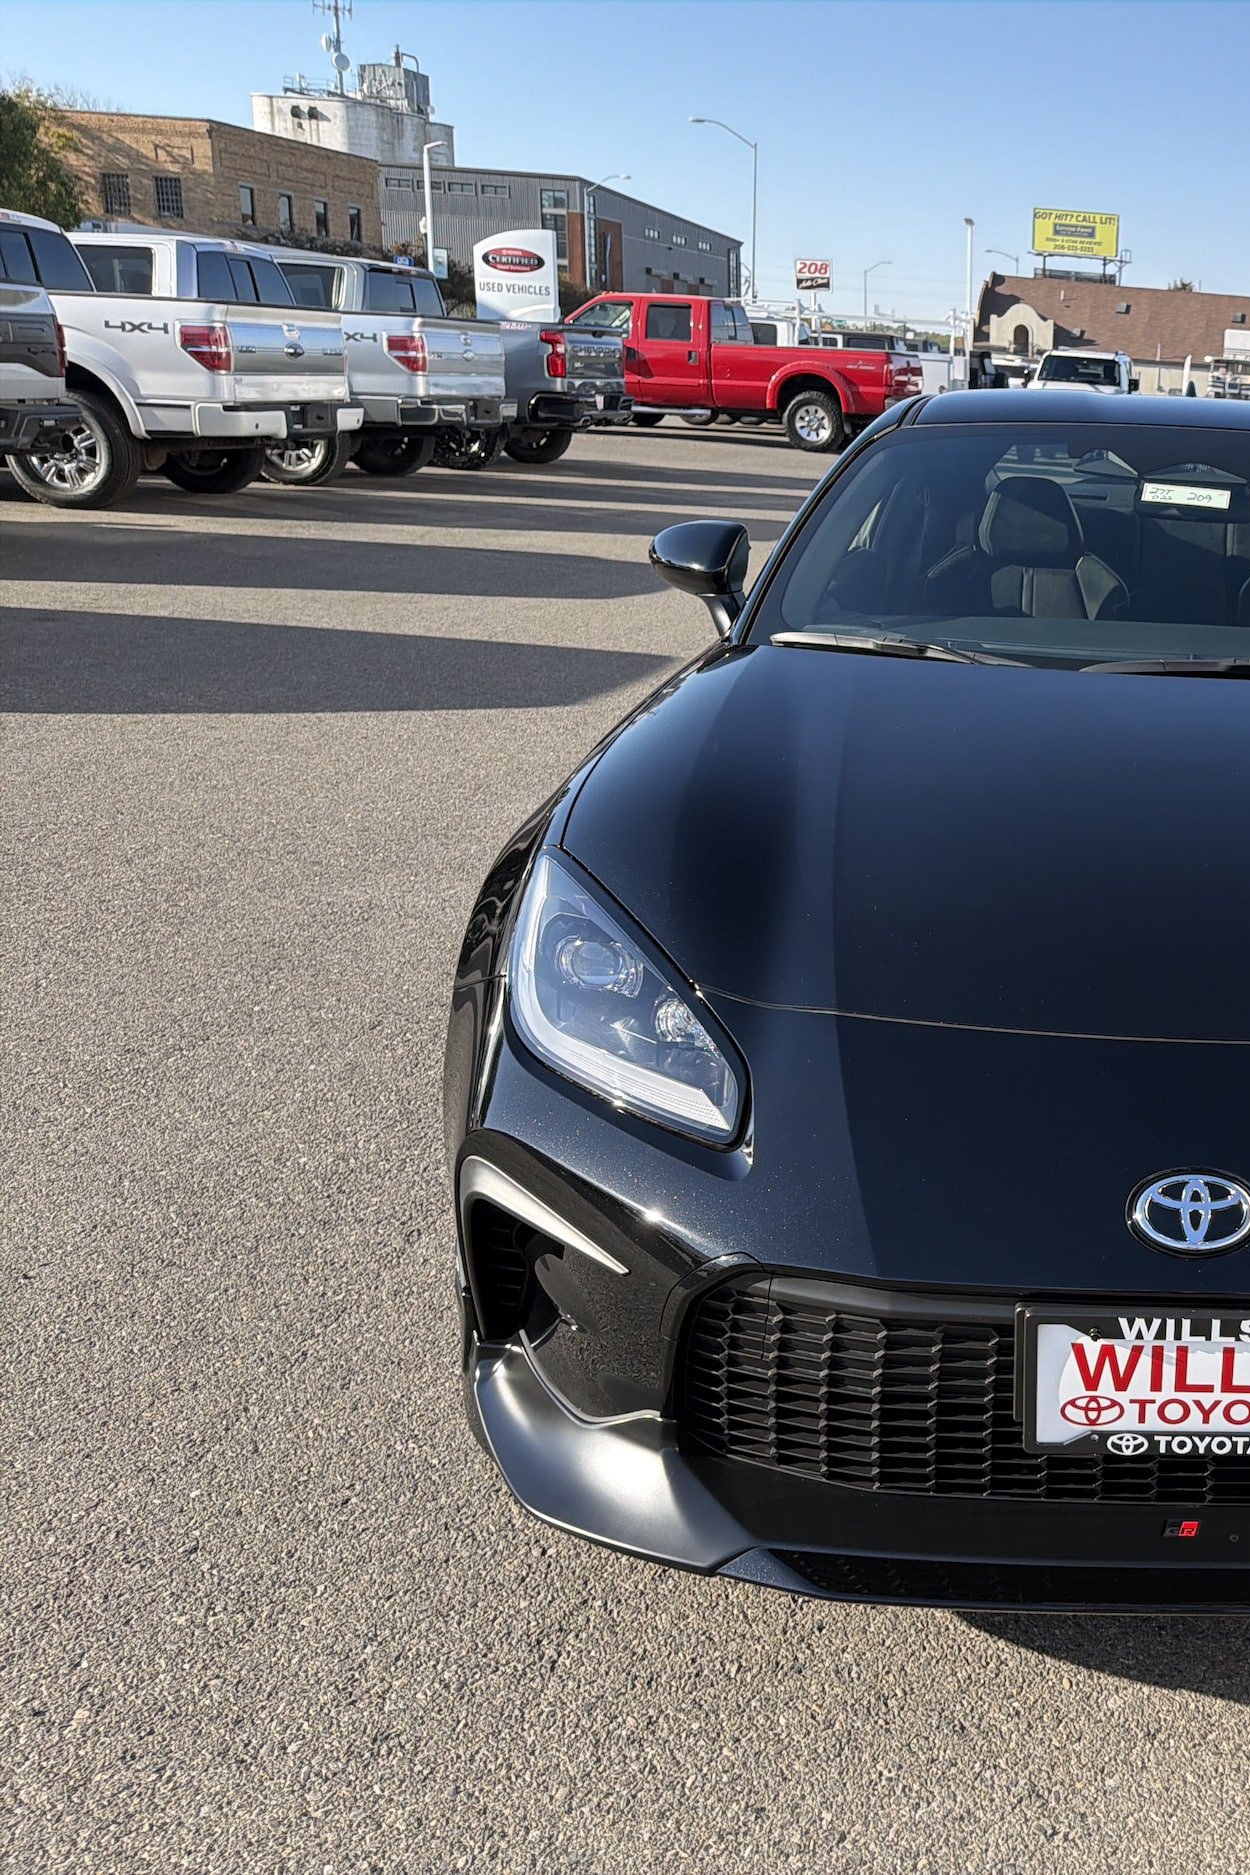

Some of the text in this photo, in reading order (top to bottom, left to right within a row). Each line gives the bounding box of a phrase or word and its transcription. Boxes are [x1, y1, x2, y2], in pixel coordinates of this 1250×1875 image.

[1035, 211, 1053, 220] GOT
[1054, 212, 1074, 222] HIT?
[1075, 214, 1098, 225] CALL
[797, 262, 829, 275] 208
[479, 281, 551, 297] USED VEHICLES
[344, 331, 377, 342] X4
